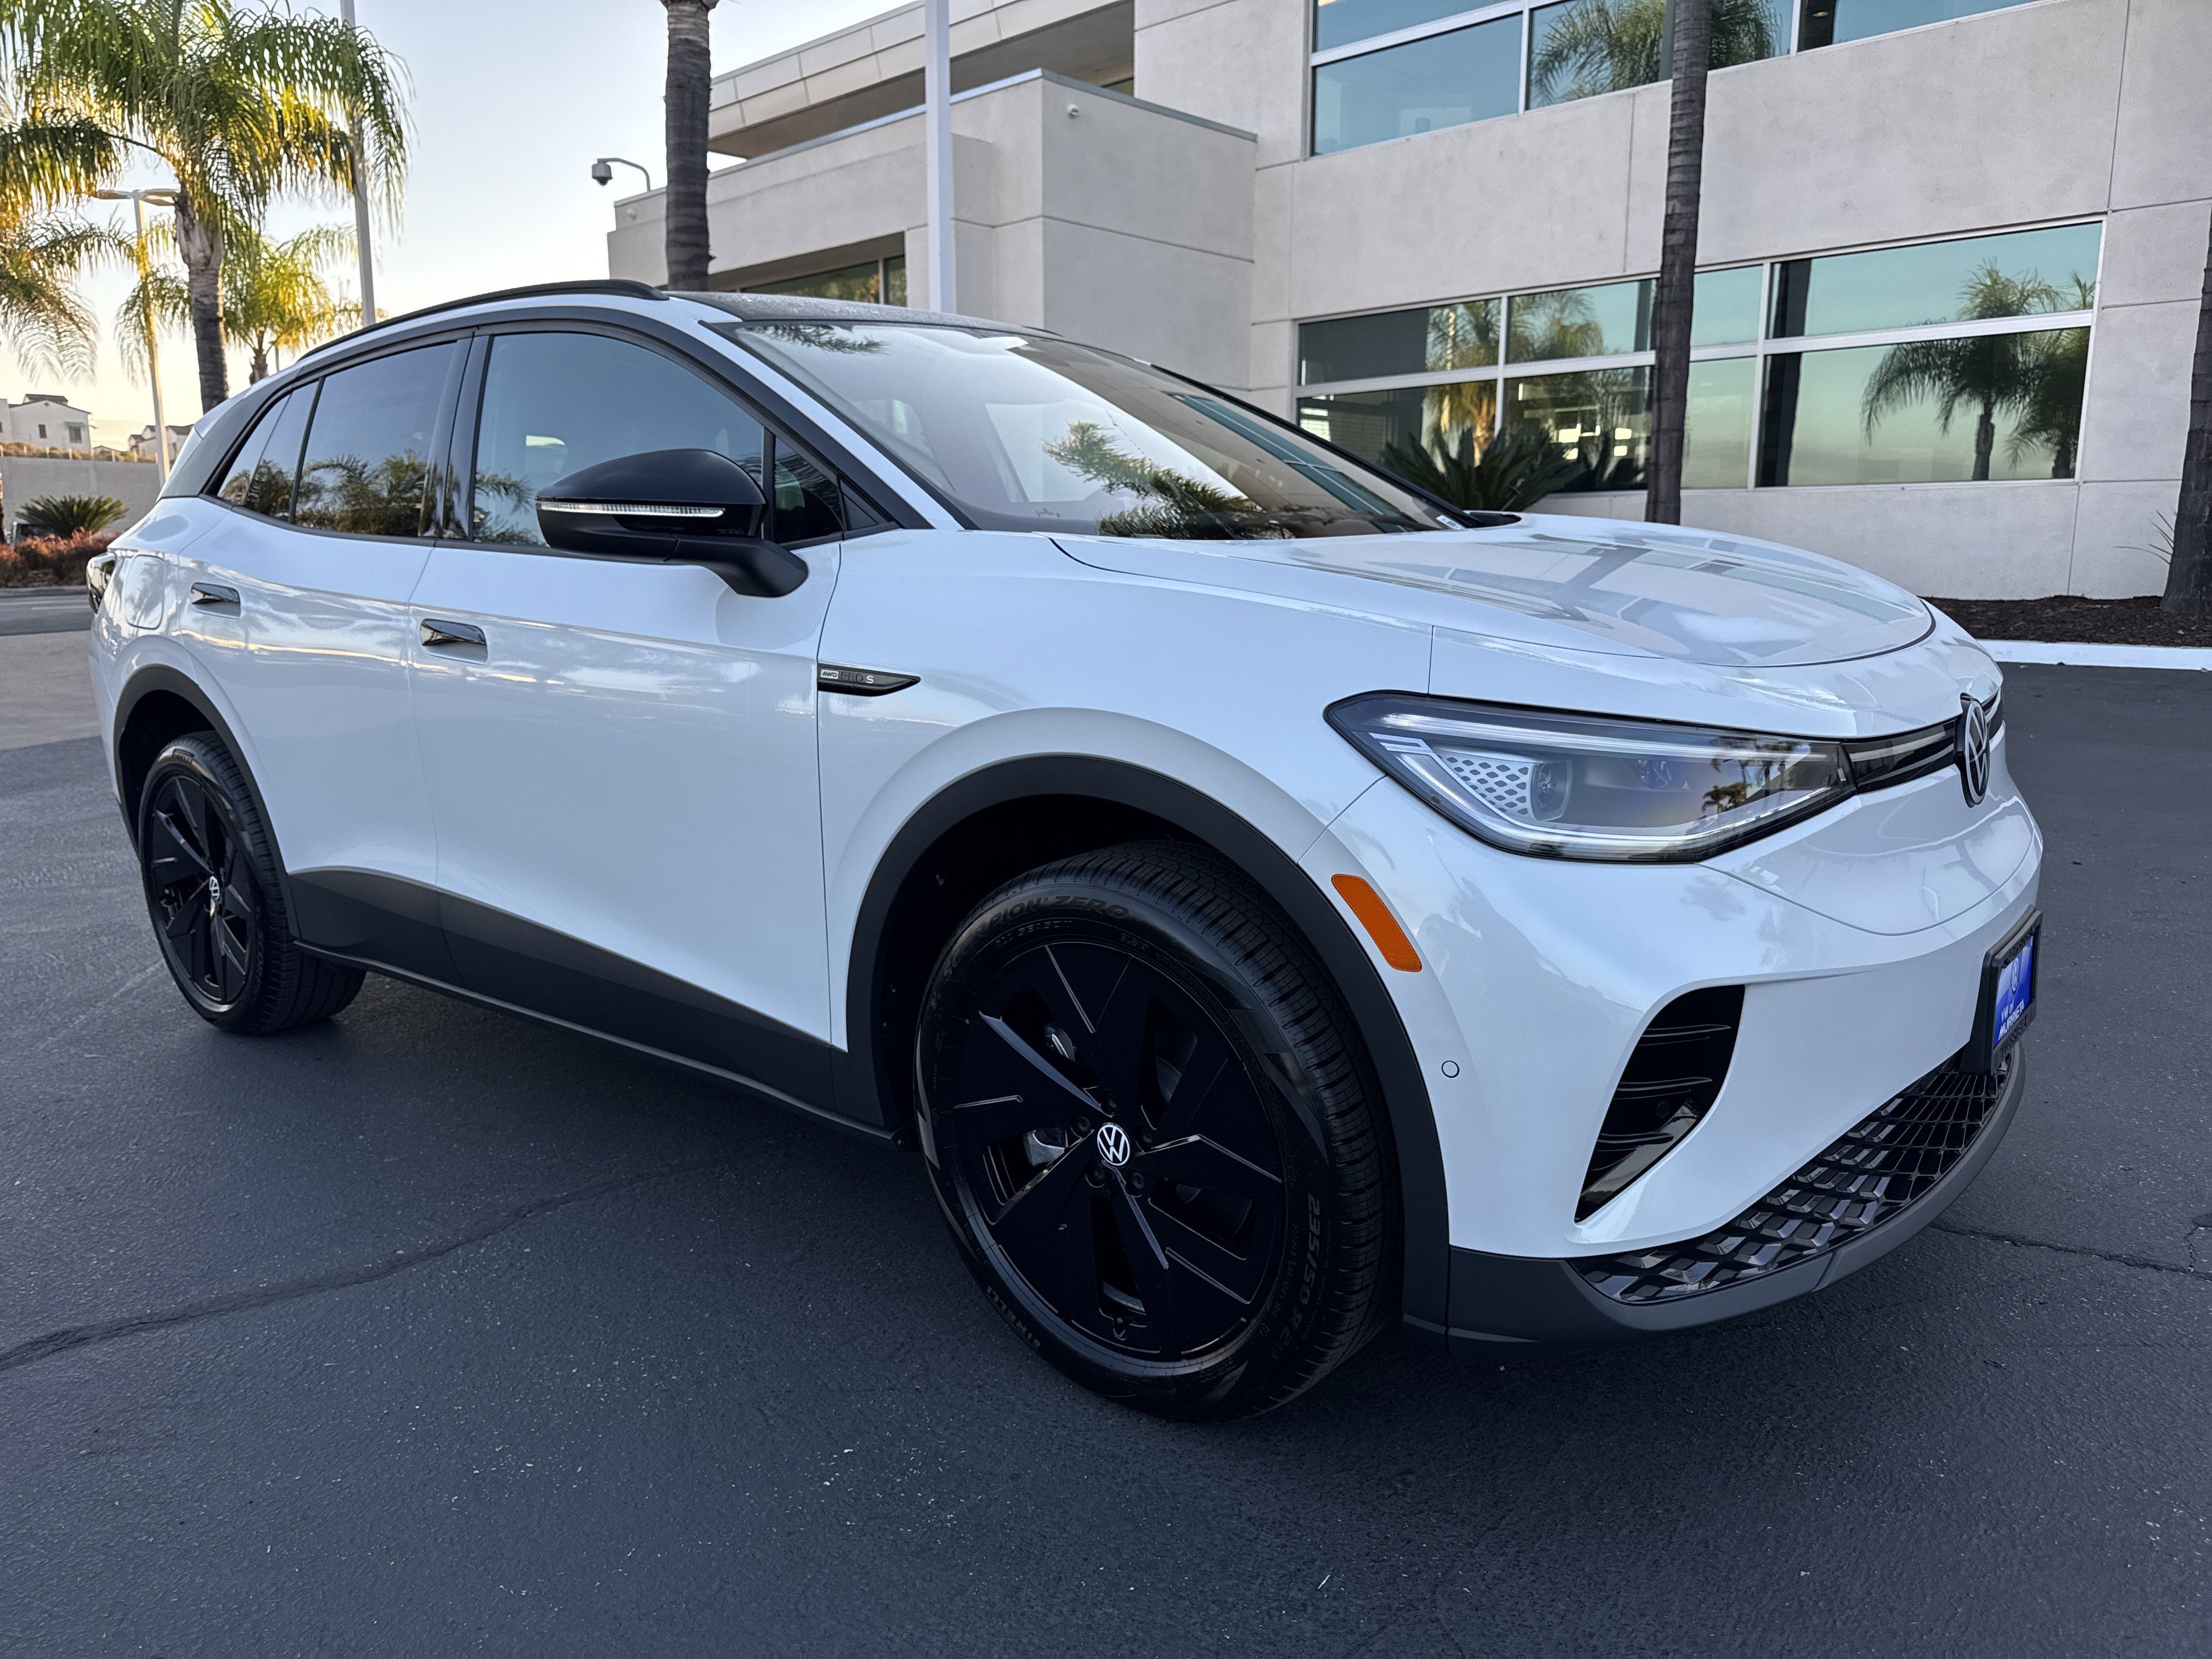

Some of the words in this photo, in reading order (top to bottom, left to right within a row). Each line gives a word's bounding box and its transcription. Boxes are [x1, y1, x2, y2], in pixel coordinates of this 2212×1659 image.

[841, 671, 864, 682] PRO
[866, 675, 874, 684] S
[1052, 895, 1129, 919] ZERO
[2001, 1003, 2010, 1024] VW
[1097, 1124, 1131, 1166] VW
[1300, 1192, 1321, 1305] 235/50
